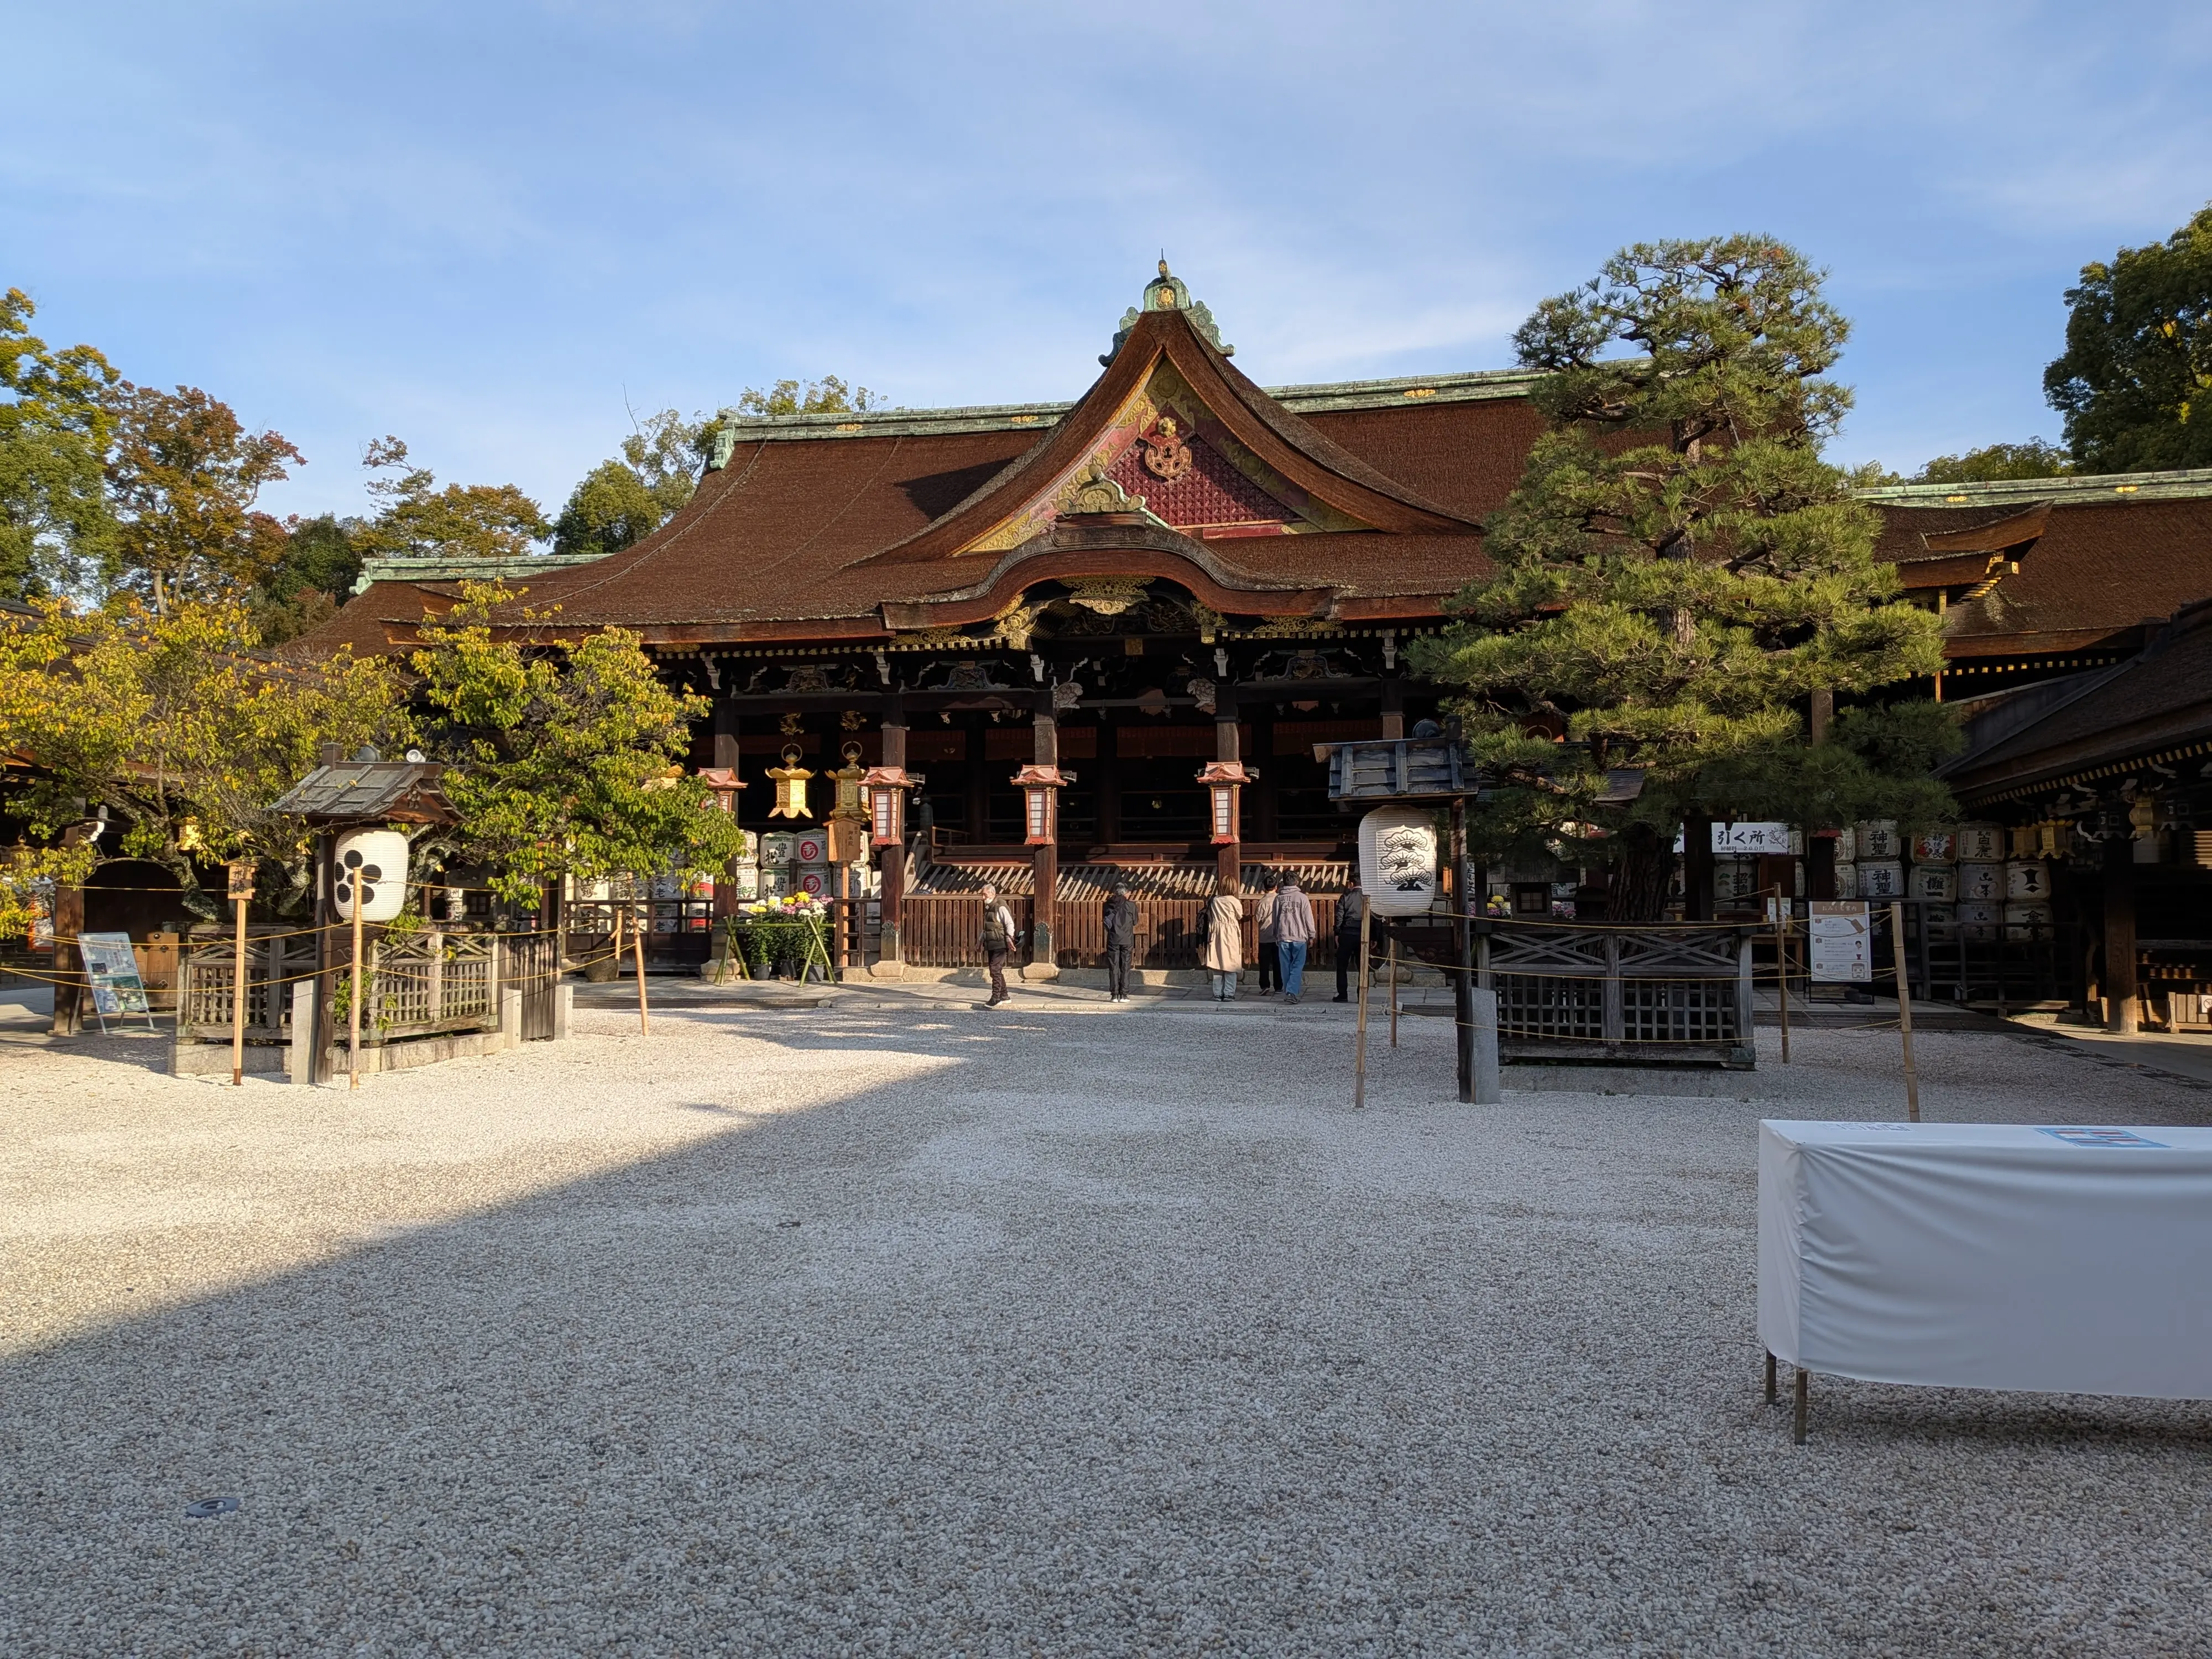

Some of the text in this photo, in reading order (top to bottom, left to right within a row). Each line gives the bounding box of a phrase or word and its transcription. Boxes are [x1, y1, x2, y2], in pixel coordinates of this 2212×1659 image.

[1717, 830, 1766, 845] 引く所
[1869, 829, 1890, 857] 神聖
[1871, 869, 1893, 895] 神聖
[1979, 872, 1993, 898] 山本
